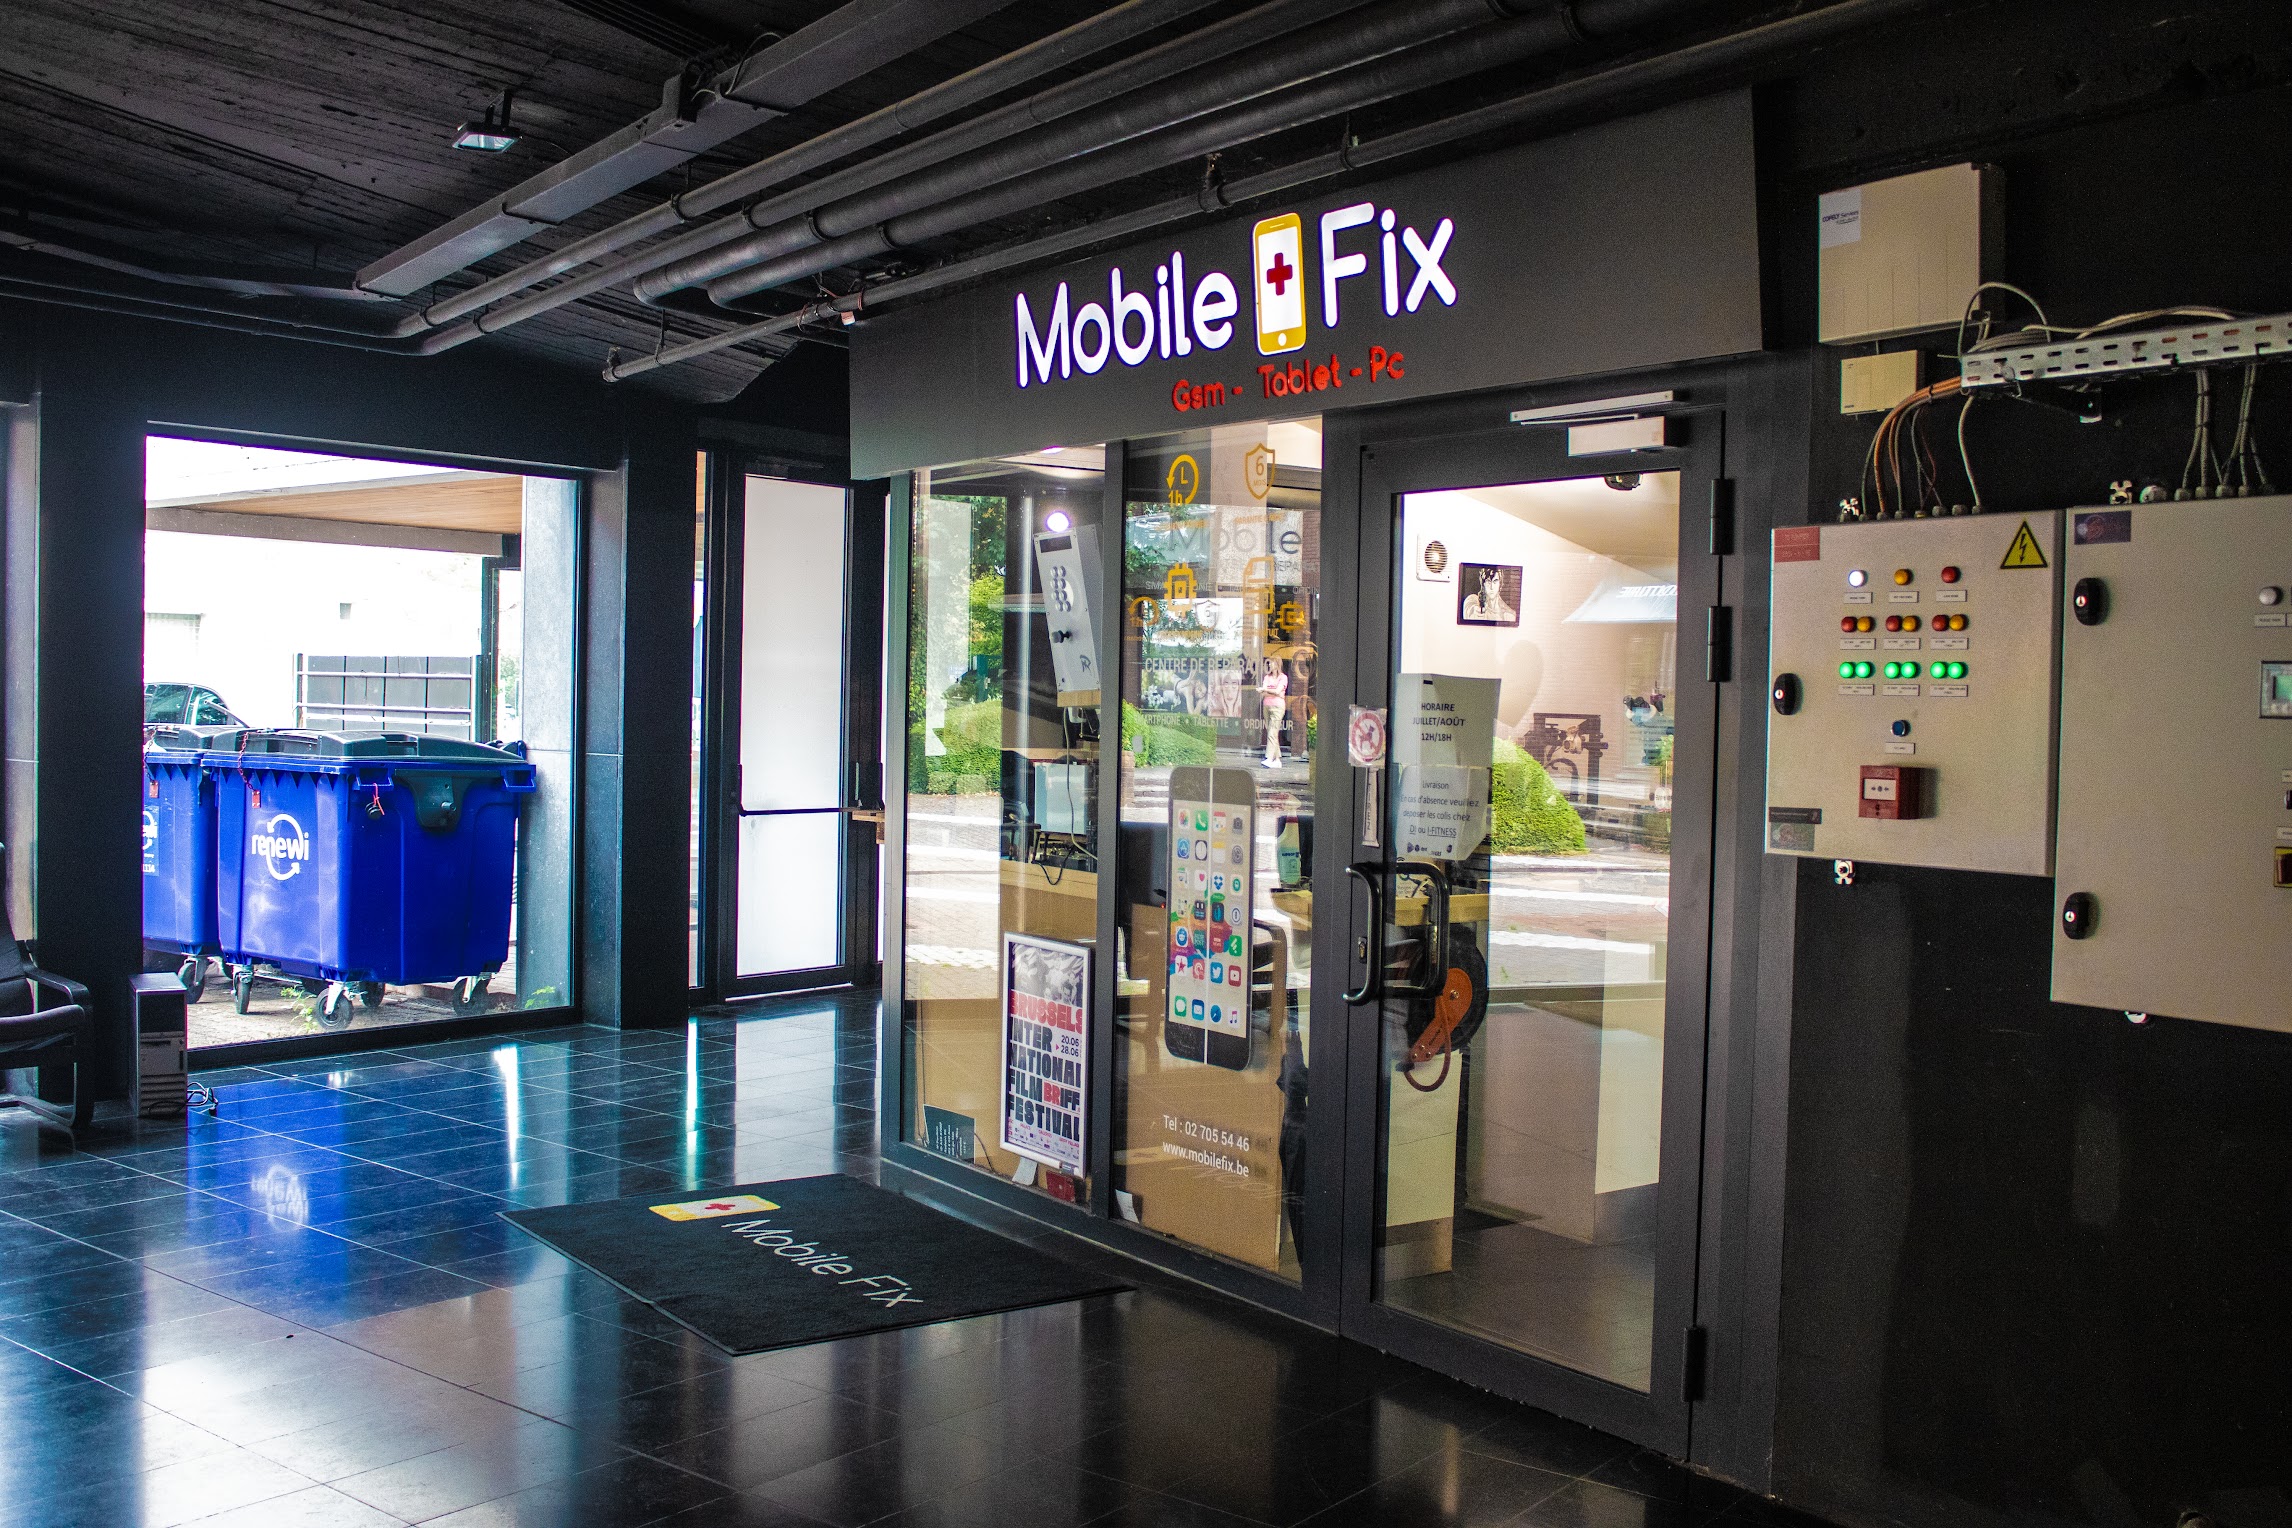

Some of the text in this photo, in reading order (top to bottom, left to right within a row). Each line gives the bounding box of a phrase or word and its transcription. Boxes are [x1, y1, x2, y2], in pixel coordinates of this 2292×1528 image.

[1015, 202, 1458, 387] Mobile Fix
[1172, 378, 1226, 412] Gsm
[1257, 354, 1342, 399] Tablet
[1369, 346, 1405, 382] Pc
[1255, 455, 1265, 476] 6
[1168, 489, 1183, 508] 1h
[1145, 657, 1187, 673] CENTRE
[1190, 659, 1205, 674] DE
[1421, 702, 1455, 712] HORAIRE
[1193, 716, 1229, 729] TABLETTE
[1412, 716, 1465, 727] JUILLET/AOÛT
[1421, 733, 1452, 742] 12H/18H
[1422, 780, 1449, 790] Livraison
[1417, 795, 1448, 806] d'absence
[1427, 810, 1436, 819] les
[1437, 811, 1451, 820] colis
[1453, 812, 1470, 822] chez
[251, 833, 310, 862] renewi
[1010, 988, 1083, 1035] BRUSSELS
[1061, 1045, 1079, 1057] 28.06
[1008, 1093, 1080, 1142] FESTIVAL
[1163, 1114, 1177, 1131] Tel
[1185, 1121, 1197, 1137] 02
[1200, 1124, 1219, 1143] 705
[1221, 1131, 1233, 1147] 54
[1237, 1137, 1249, 1152] 46
[1162, 1141, 1249, 1177] www.mobilefix.be
[721, 1219, 923, 1307] Mobile Fix
